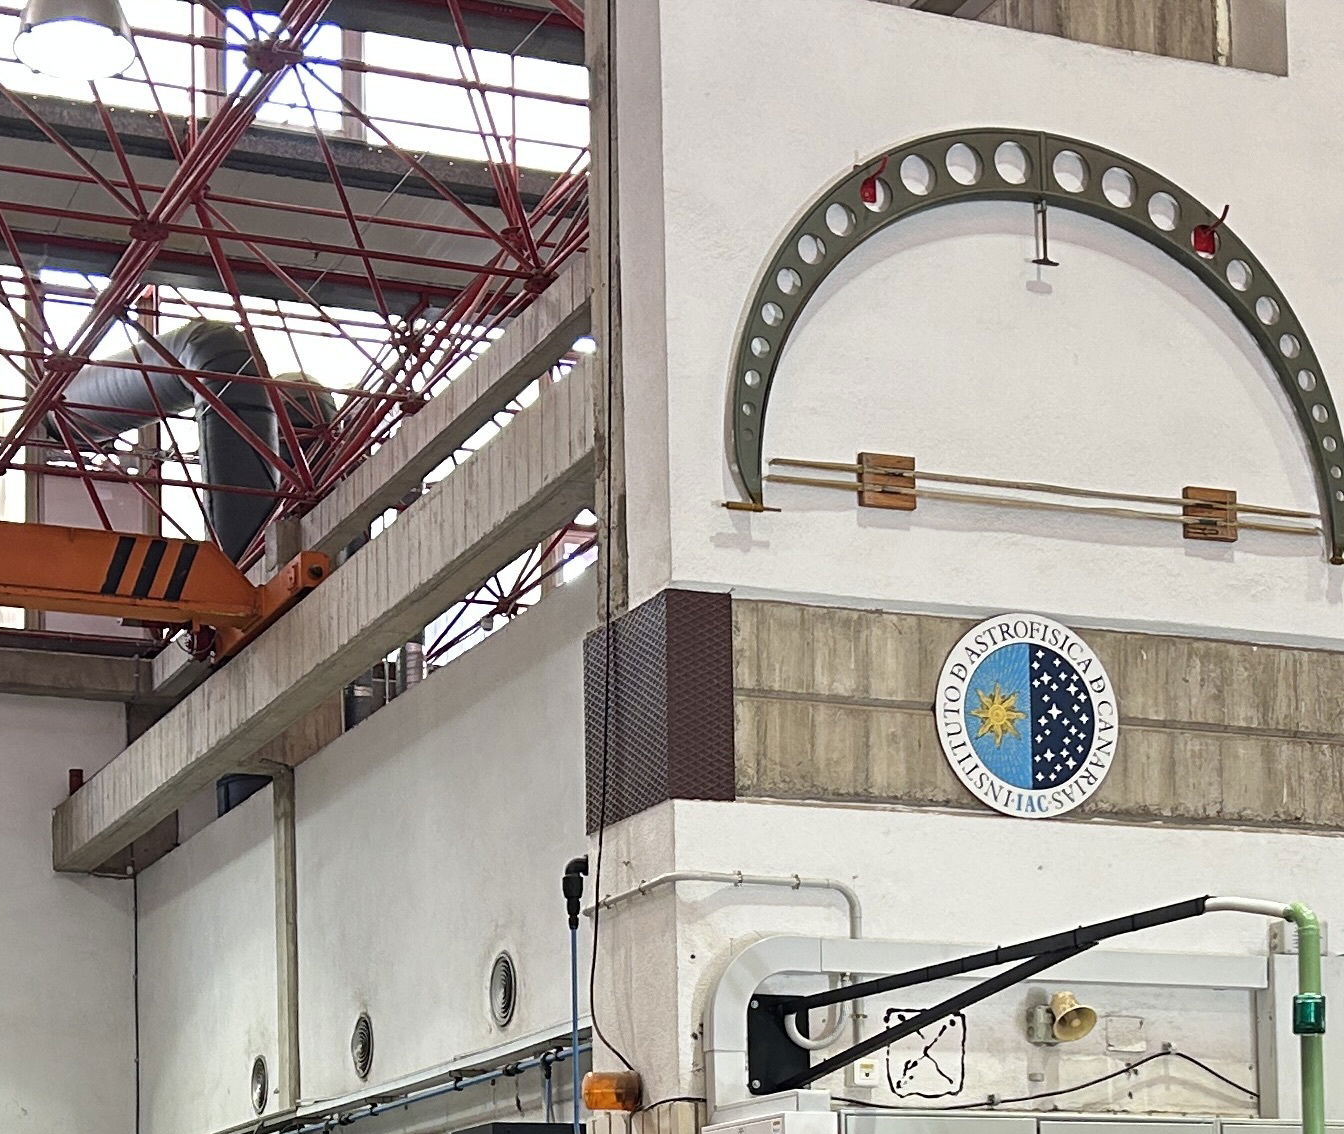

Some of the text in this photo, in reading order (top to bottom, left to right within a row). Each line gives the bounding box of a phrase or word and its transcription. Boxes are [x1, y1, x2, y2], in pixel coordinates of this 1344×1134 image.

[964, 620, 1094, 674] ASTROFISICA
[944, 685, 1012, 807] INSTITUTO
[1051, 700, 1114, 810] CANARIAS
[1015, 793, 1049, 813] IAC
